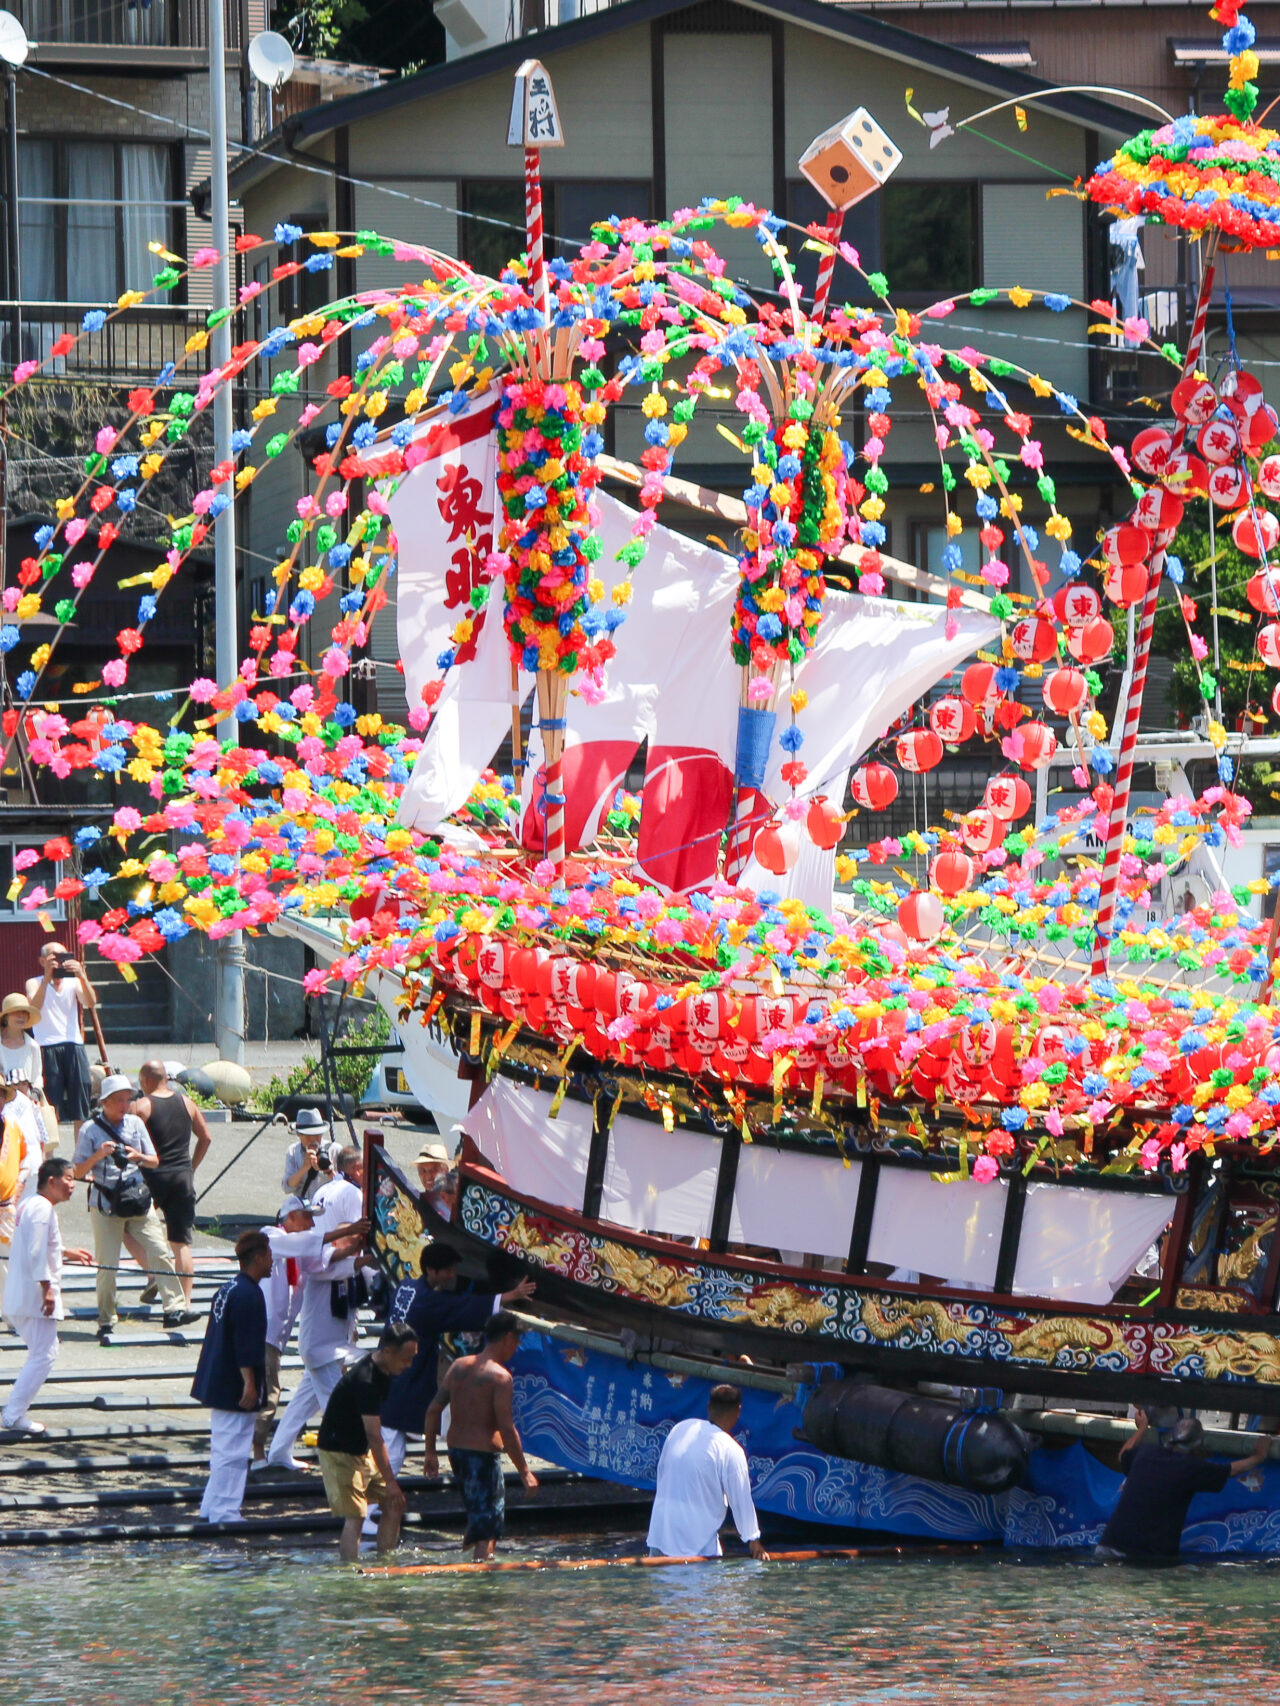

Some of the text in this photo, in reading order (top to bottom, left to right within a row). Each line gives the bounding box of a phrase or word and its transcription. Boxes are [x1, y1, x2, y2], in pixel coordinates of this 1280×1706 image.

[530, 77, 555, 138] 王将
[1207, 430, 1232, 455] 東
[1213, 474, 1236, 497] 東
[1139, 493, 1156, 516] 東
[1071, 594, 1093, 617] 東
[1013, 622, 1031, 645] 東
[936, 706, 957, 730] 東
[990, 785, 1011, 808] 東
[479, 949, 500, 975] 東
[694, 1001, 715, 1026] 東
[768, 1005, 787, 1030] 東
